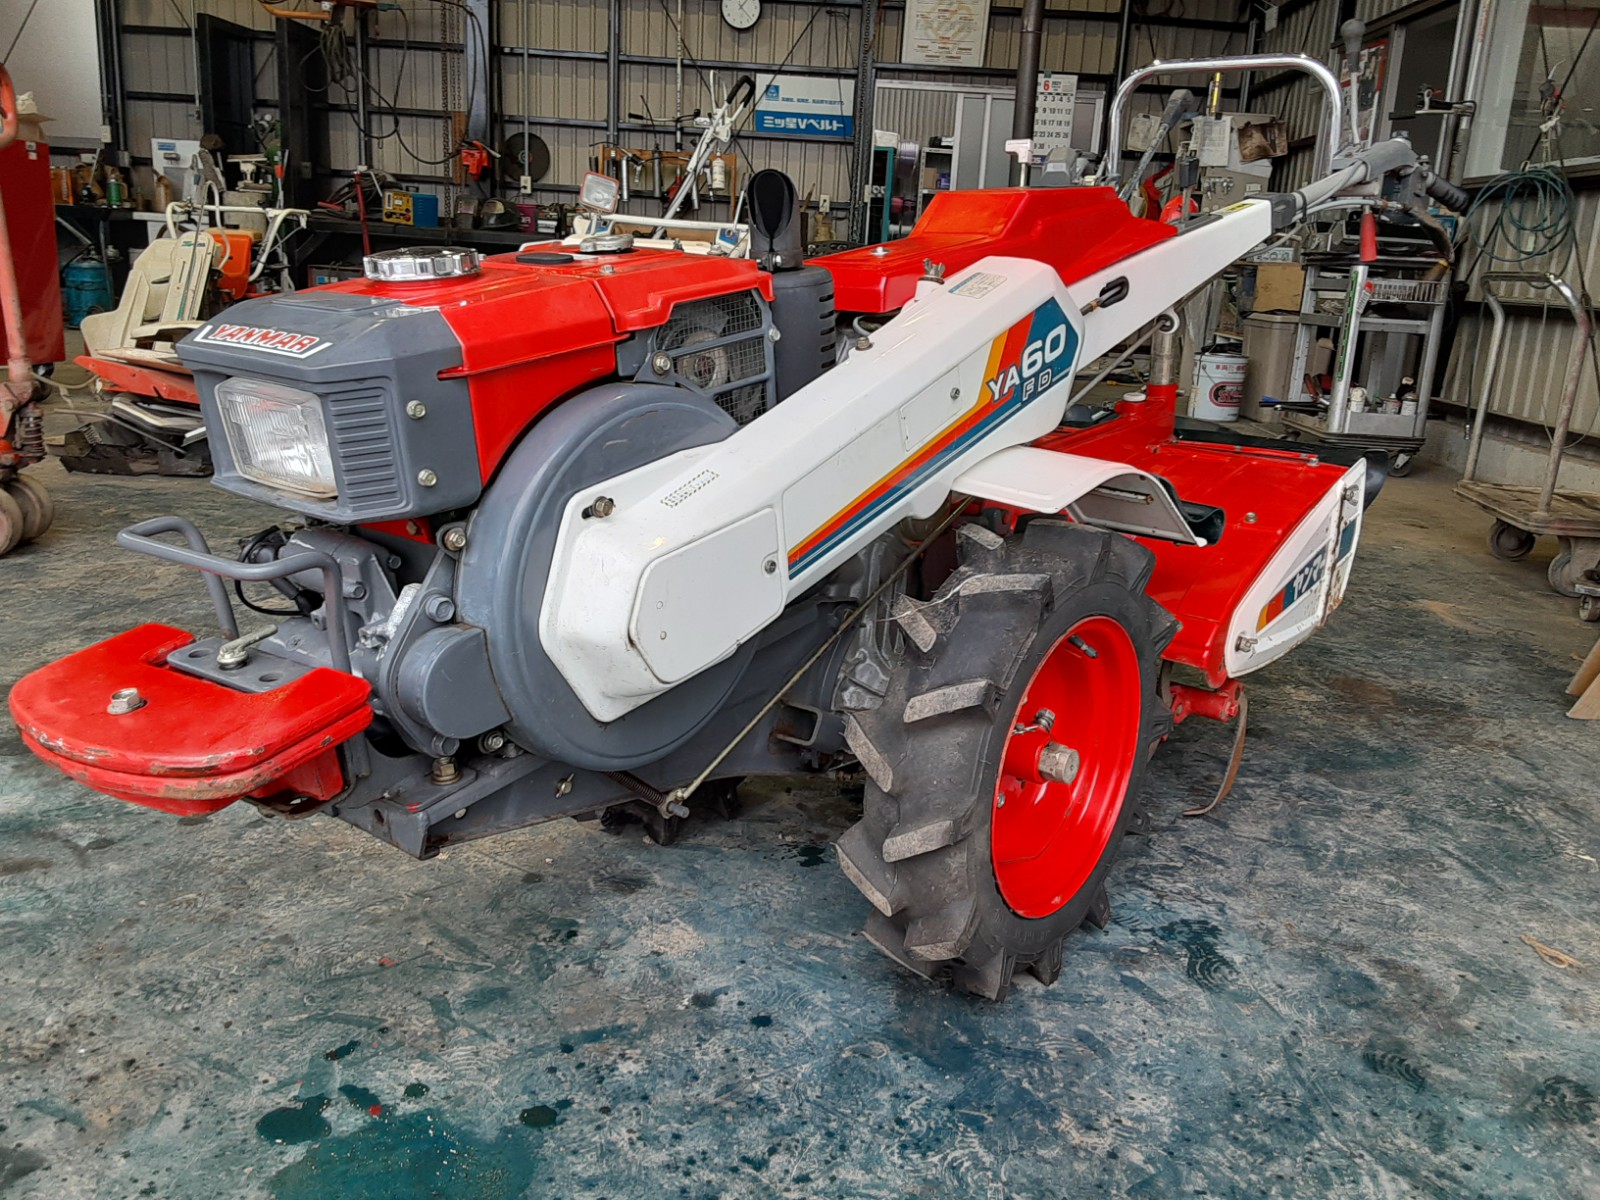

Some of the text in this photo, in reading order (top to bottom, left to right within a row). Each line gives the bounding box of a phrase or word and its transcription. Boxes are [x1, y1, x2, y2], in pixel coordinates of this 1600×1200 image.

[1043, 79, 1050, 91] 6
[208, 323, 320, 353] YANMAR
[985, 323, 1067, 402] YA60
